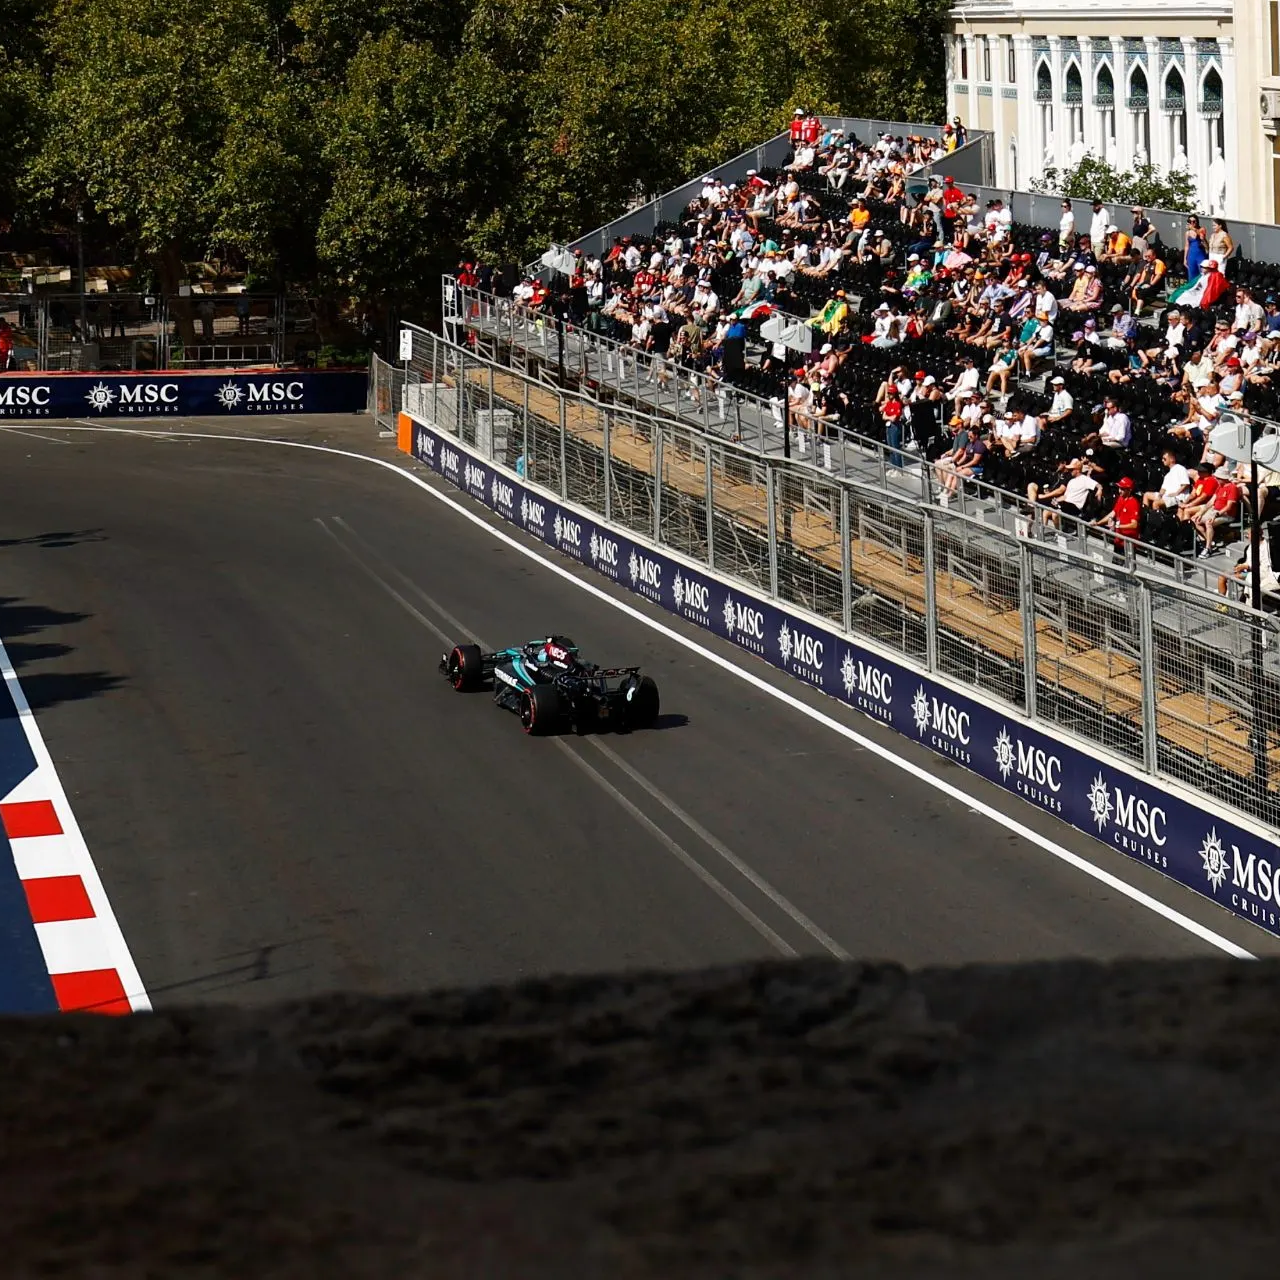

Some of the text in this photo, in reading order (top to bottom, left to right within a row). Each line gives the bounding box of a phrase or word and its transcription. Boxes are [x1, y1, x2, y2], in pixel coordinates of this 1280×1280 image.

[120, 384, 179, 403] MSC
[247, 382, 304, 401] MSC
[423, 434, 435, 457] MSC
[446, 449, 459, 474] MSC
[470, 464, 485, 490] MSC
[498, 481, 513, 508] MSC
[528, 499, 545, 527] MSC
[562, 517, 581, 546] MSC
[599, 535, 618, 566] MSC
[638, 556, 661, 589] MSC
[685, 578, 710, 613] MSC
[736, 602, 764, 640] MSC
[793, 629, 824, 670] MSC
[793, 663, 823, 686] CRUISES
[858, 660, 892, 705] MSC
[858, 696, 892, 722] CRUISES
[932, 696, 970, 745] MSC
[932, 735, 971, 764] CRUISES
[1016, 739, 1062, 792] MSC
[1016, 780, 1062, 813] CRUISES
[1114, 787, 1167, 847] MSC
[1114, 831, 1168, 869] CRUISES
